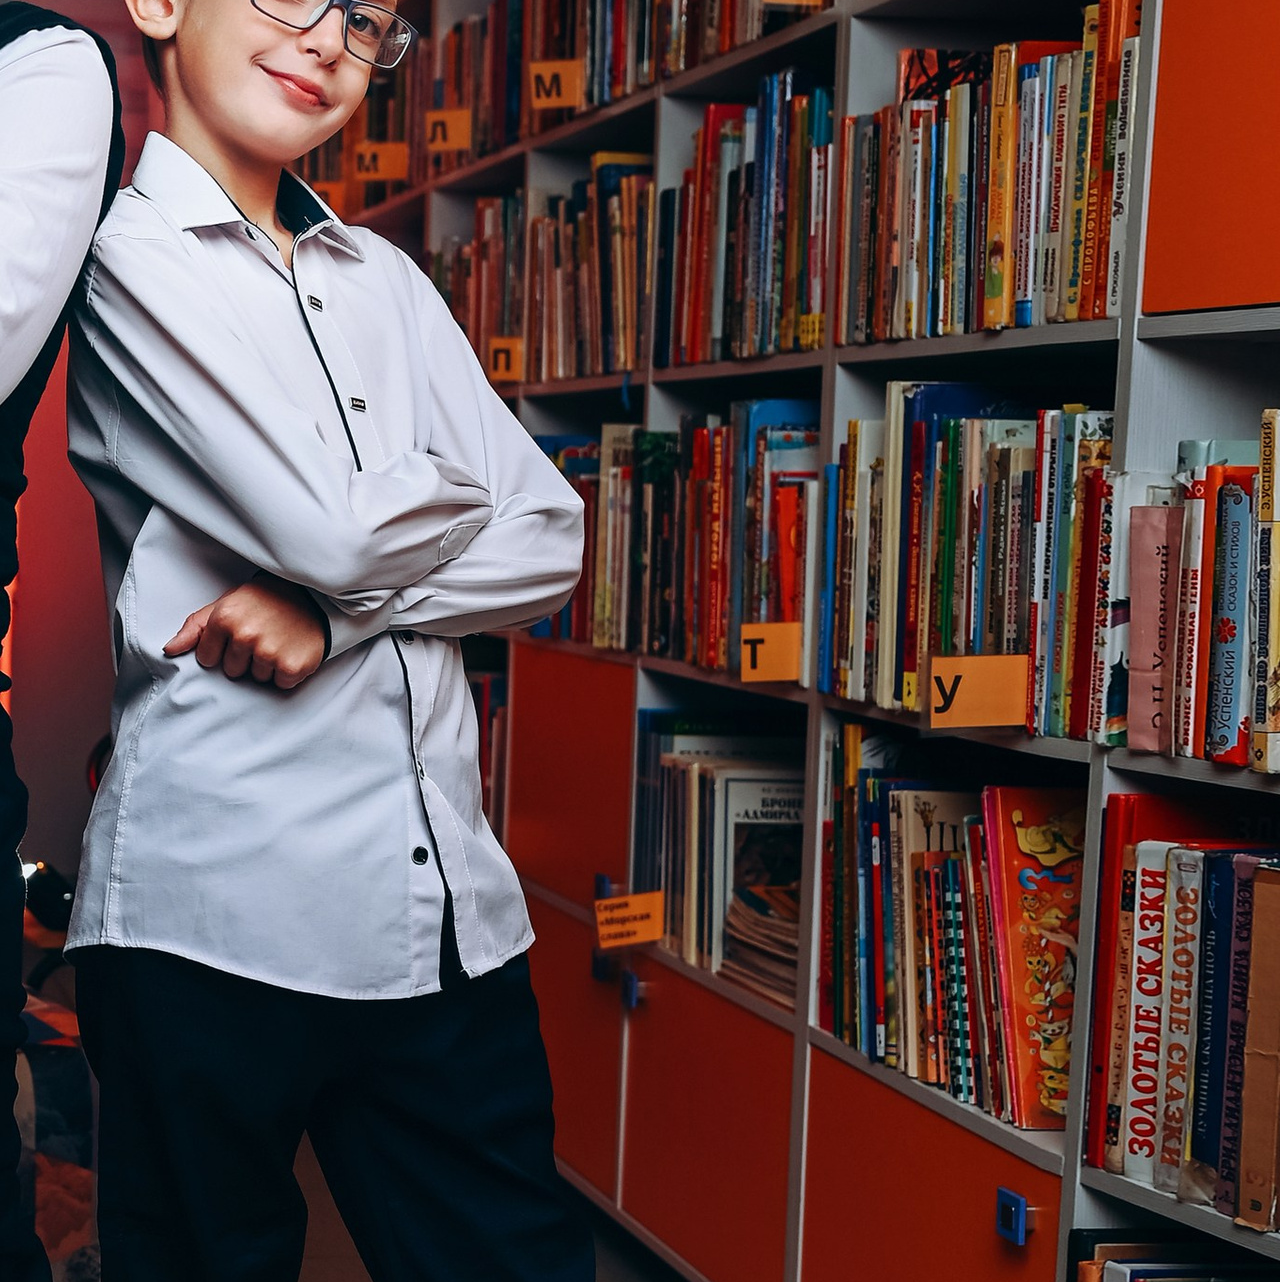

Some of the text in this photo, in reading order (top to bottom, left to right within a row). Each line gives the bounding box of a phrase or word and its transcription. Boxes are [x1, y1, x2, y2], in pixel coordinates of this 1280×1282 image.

[533, 72, 562, 98] М
[427, 123, 448, 145] Л
[357, 153, 381, 176] М
[1085, 186, 1099, 272] ПРОКОФЬЕВА
[492, 350, 511, 372] П
[1101, 484, 1111, 517] ЯГИ
[709, 520, 721, 571] ГОРОД
[1100, 519, 1111, 566] БАБЫ
[1229, 520, 1241, 559] СТИХОВ
[1099, 570, 1110, 629] АЗБУКА
[1152, 544, 1171, 672] Успенский
[1227, 571, 1239, 612] СКАЗОК
[742, 638, 765, 670] Т
[1183, 568, 1199, 747] БИЗНЕС КРОКОДИЛА ГЕНЫ
[933, 673, 963, 713] У
[1216, 650, 1236, 732] УСПЕНСКИЙ
[1127, 867, 1167, 1158] ЗОЛОТЫЕ СКАЗКИ
[1160, 885, 1199, 1168] ЗОЛОТЫЕ СКАЗКИ
[1196, 929, 1217, 1138] ЛУЧШИЕ СКАЗКИ НА НОЧЬ
[1221, 877, 1253, 1183] БРИЛЛИАНТОВАЯ КНИГА СКАЗОК
